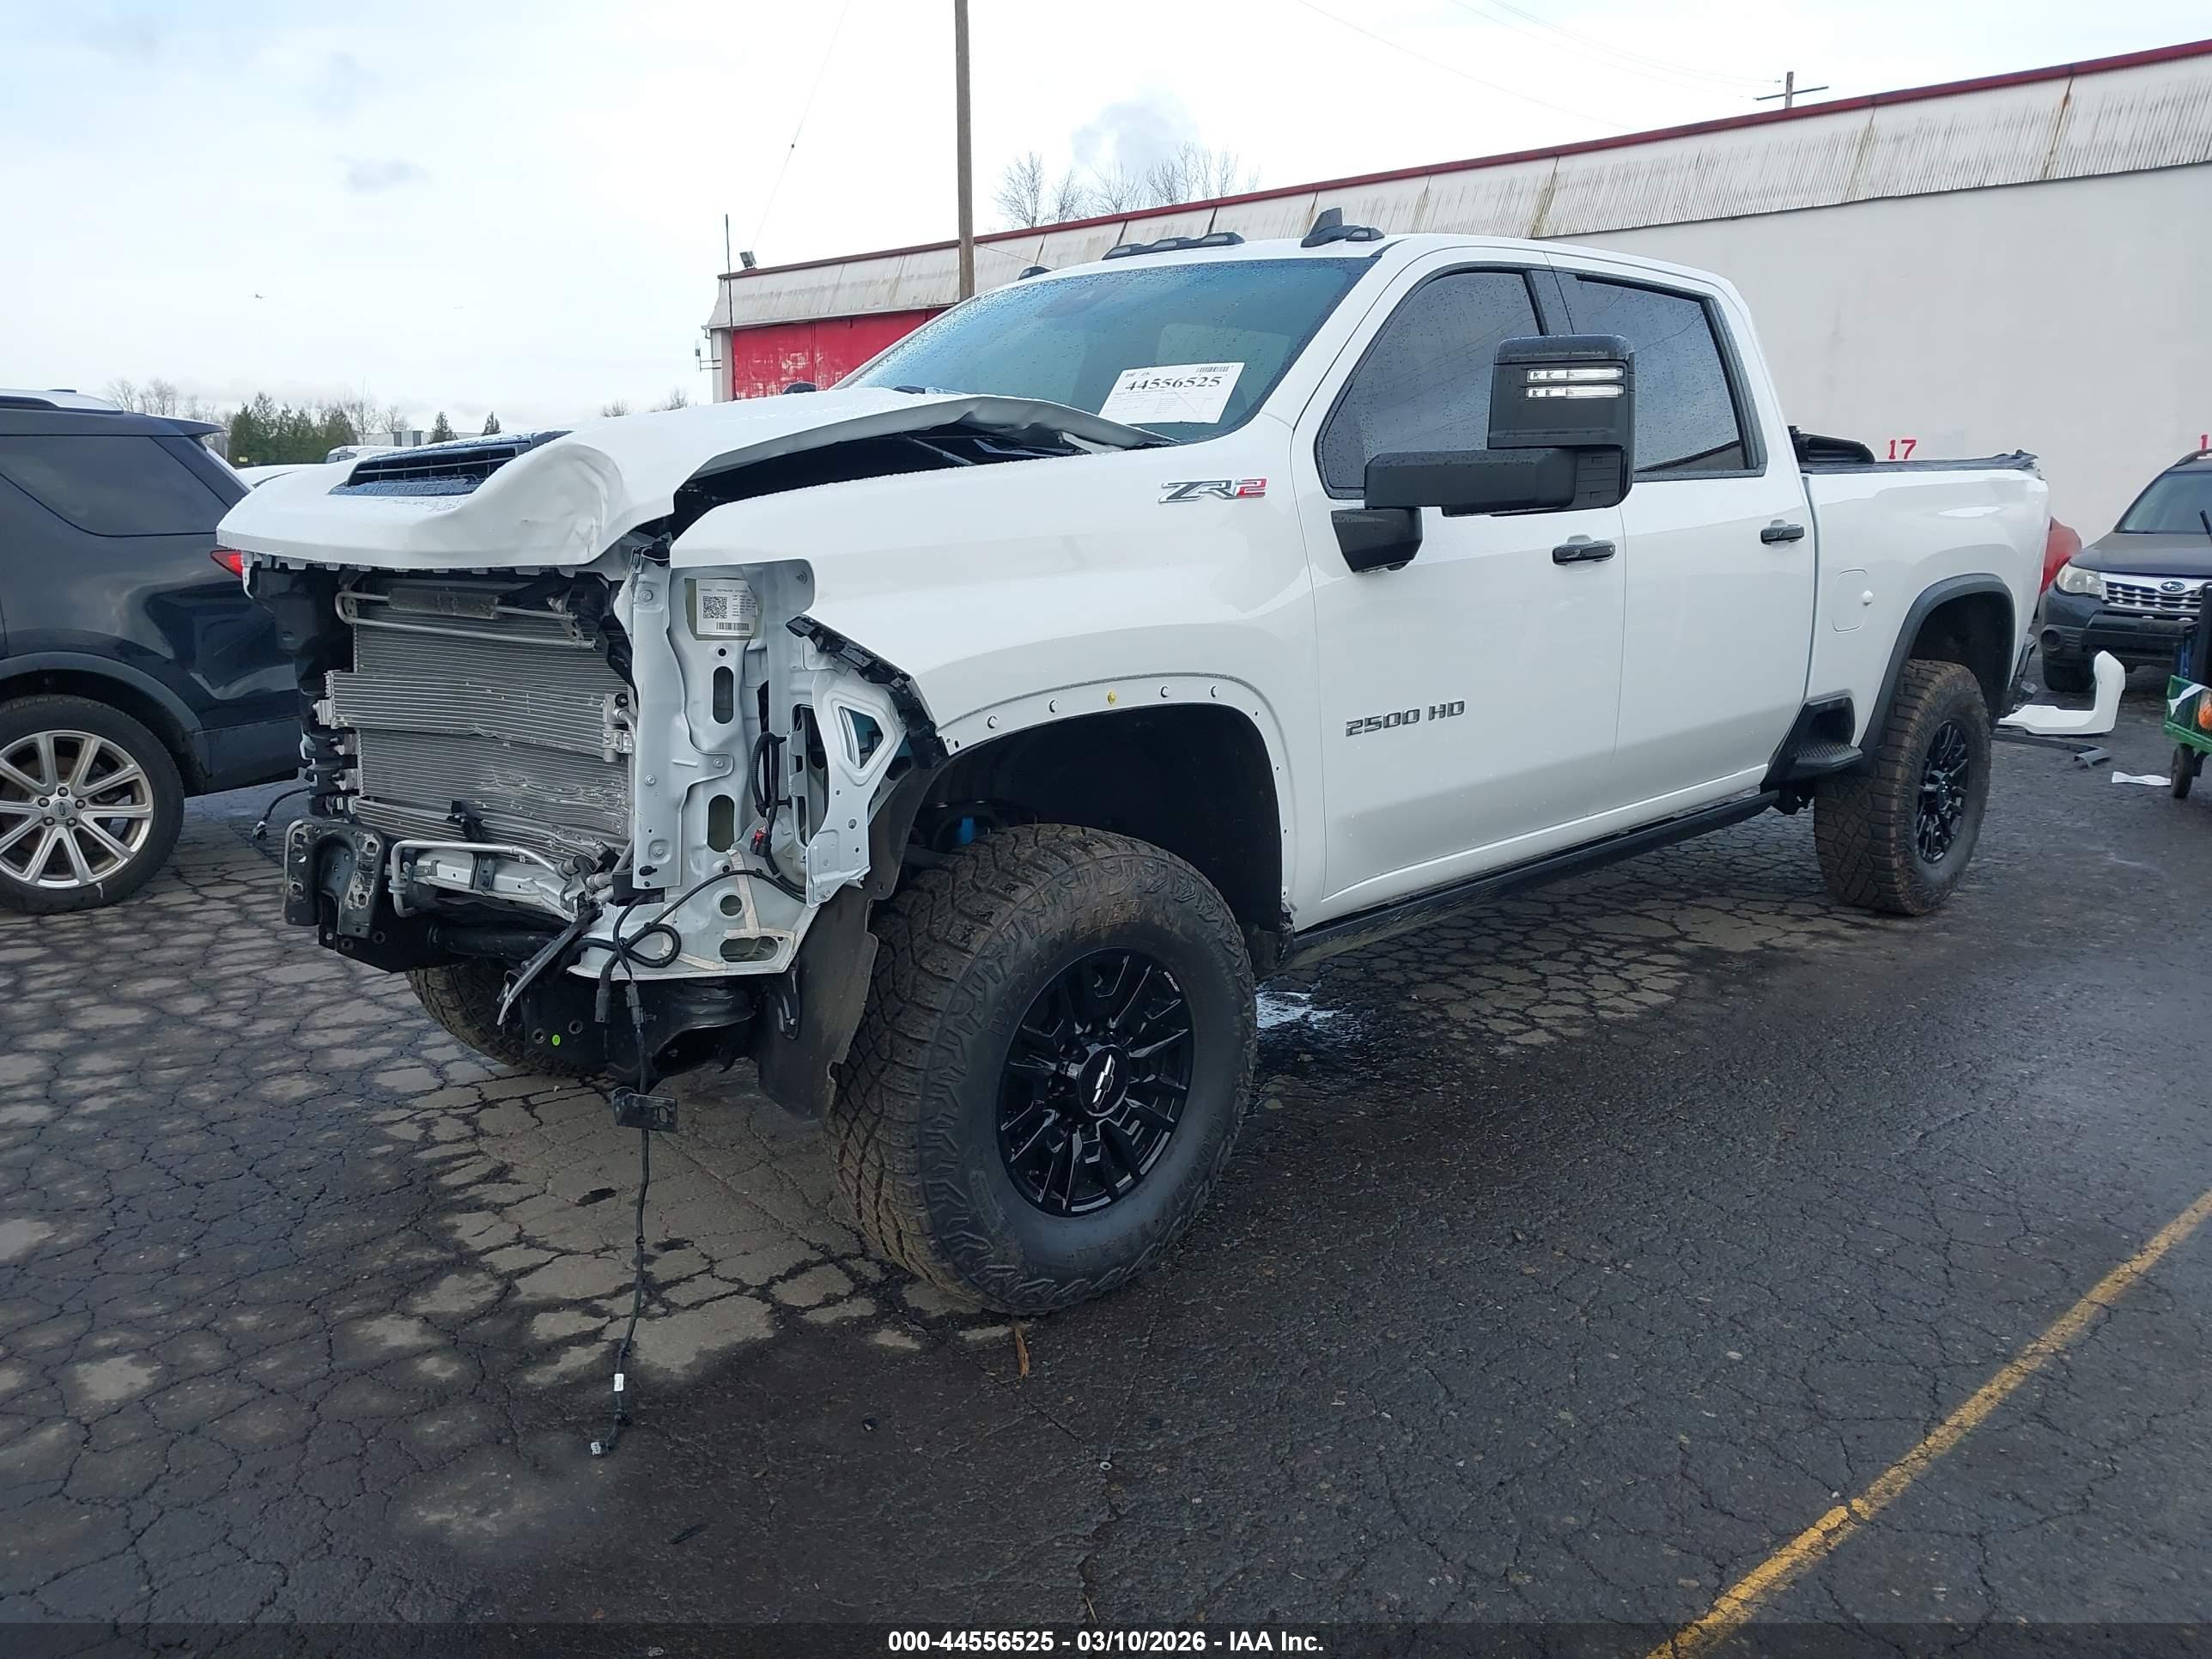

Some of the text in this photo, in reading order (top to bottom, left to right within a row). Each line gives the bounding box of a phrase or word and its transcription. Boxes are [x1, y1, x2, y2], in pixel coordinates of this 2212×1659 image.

[1125, 376, 1222, 391] 44556525
[1888, 439, 1917, 459] 17
[1158, 478, 1267, 504] ZR2
[1346, 701, 1465, 737] 2500 HD
